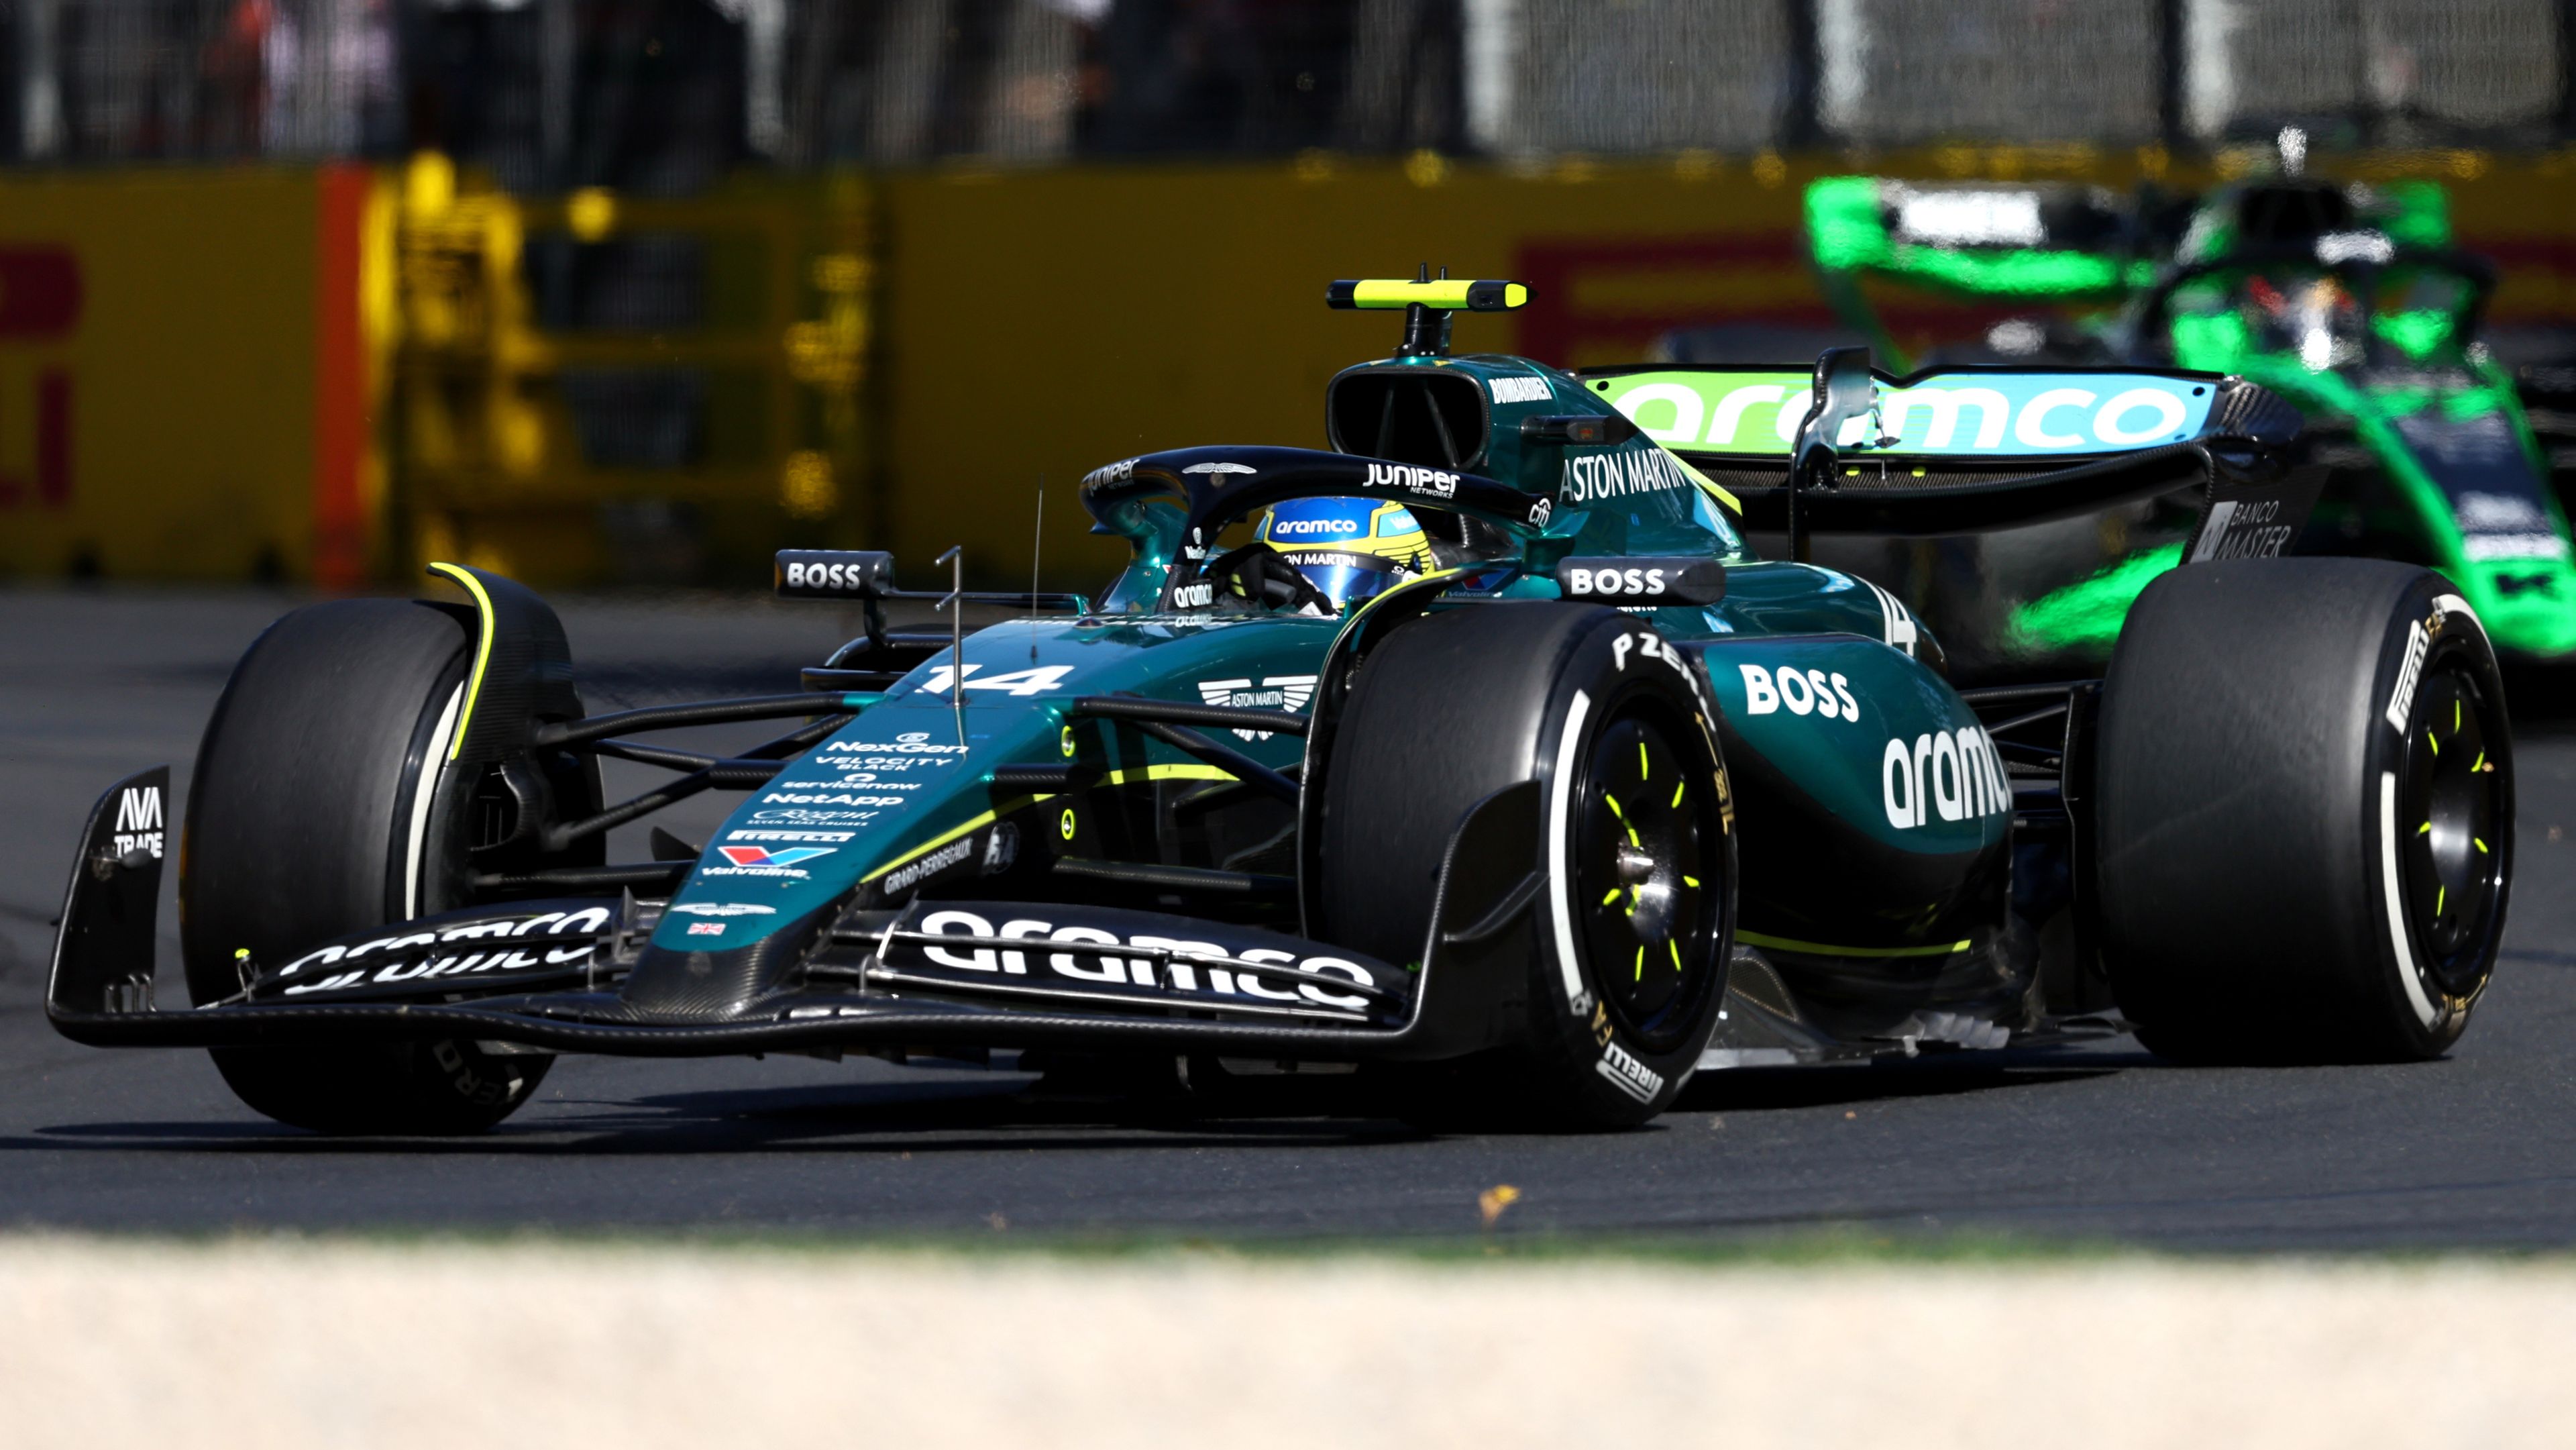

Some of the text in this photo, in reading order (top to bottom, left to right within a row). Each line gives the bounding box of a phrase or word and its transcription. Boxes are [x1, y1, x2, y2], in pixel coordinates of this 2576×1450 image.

[1488, 376, 1553, 404] BOMBARDIER
[1558, 448, 1686, 503] ASTON MARTIN
[1409, 486, 1454, 499] NETWORKS
[1275, 519, 1358, 534] aramco
[2230, 501, 2279, 526] BANCO
[2214, 525, 2291, 560] MASTER
[1303, 554, 1356, 567] MARTIN
[787, 562, 861, 590] BOSS
[1570, 568, 1666, 594] BOSS
[914, 664, 1075, 696] 14
[1232, 690, 1283, 707] ASTON MARTIN
[1739, 664, 1860, 723] BOSS
[826, 741, 969, 754] NexGen
[815, 756, 953, 766] VELOCITY
[781, 780, 922, 790] servicenow
[1883, 724, 2012, 829] aramc
[115, 786, 163, 832] AVA
[762, 792, 904, 807] NetApp
[113, 831, 163, 859] TRADE
[726, 829, 857, 842] PIRELLI
[702, 866, 809, 878] Valvoline
[920, 910, 1375, 1008] aramco
[1596, 1041, 1665, 1106] PIRELLI
